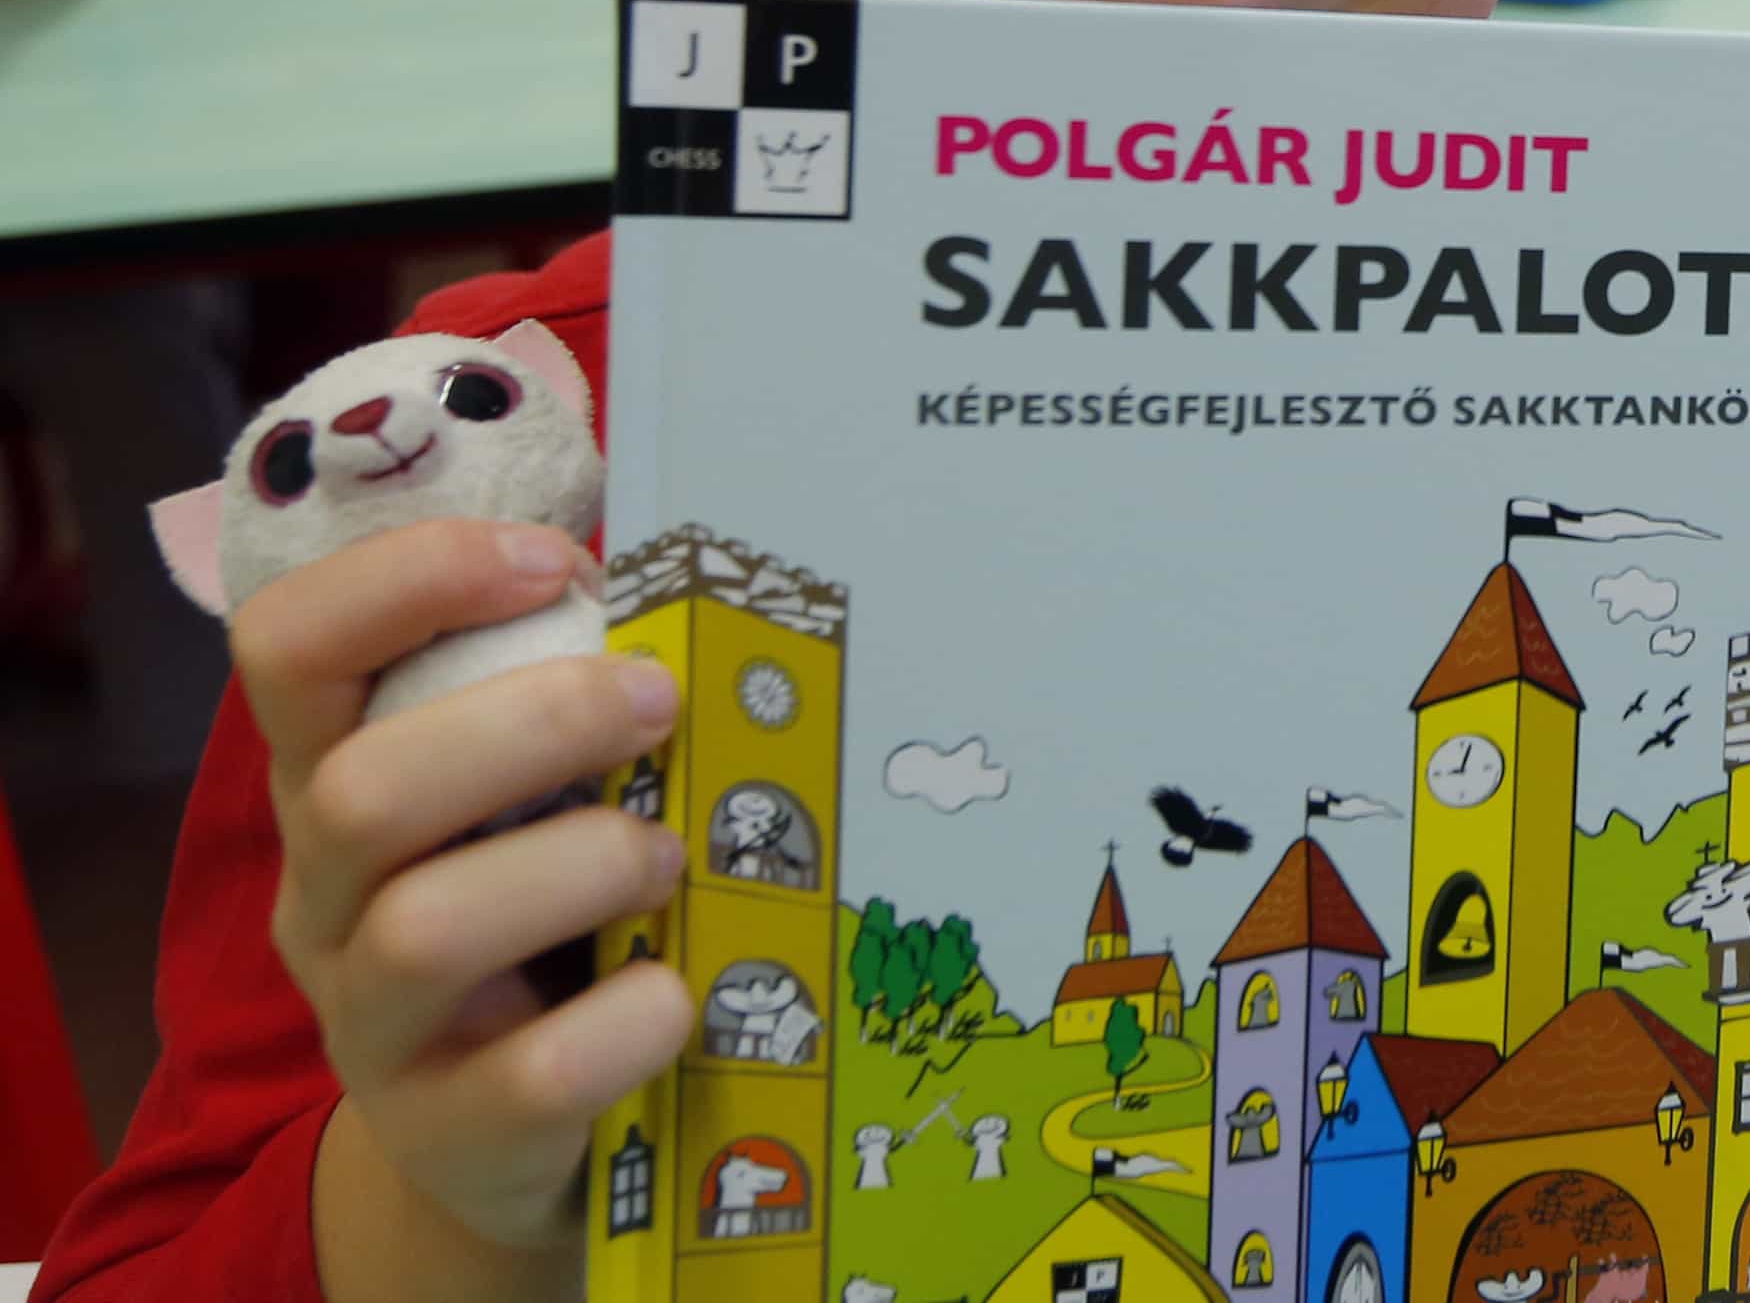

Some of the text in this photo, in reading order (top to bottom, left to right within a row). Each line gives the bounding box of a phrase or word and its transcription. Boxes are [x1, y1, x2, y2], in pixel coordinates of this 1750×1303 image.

[676, 31, 819, 85] J P
[648, 146, 721, 171] CHESS
[935, 107, 1590, 206] POLGÁR JUDIT
[916, 384, 1438, 437] KÉPESSÉGFEJLESZTŐ
